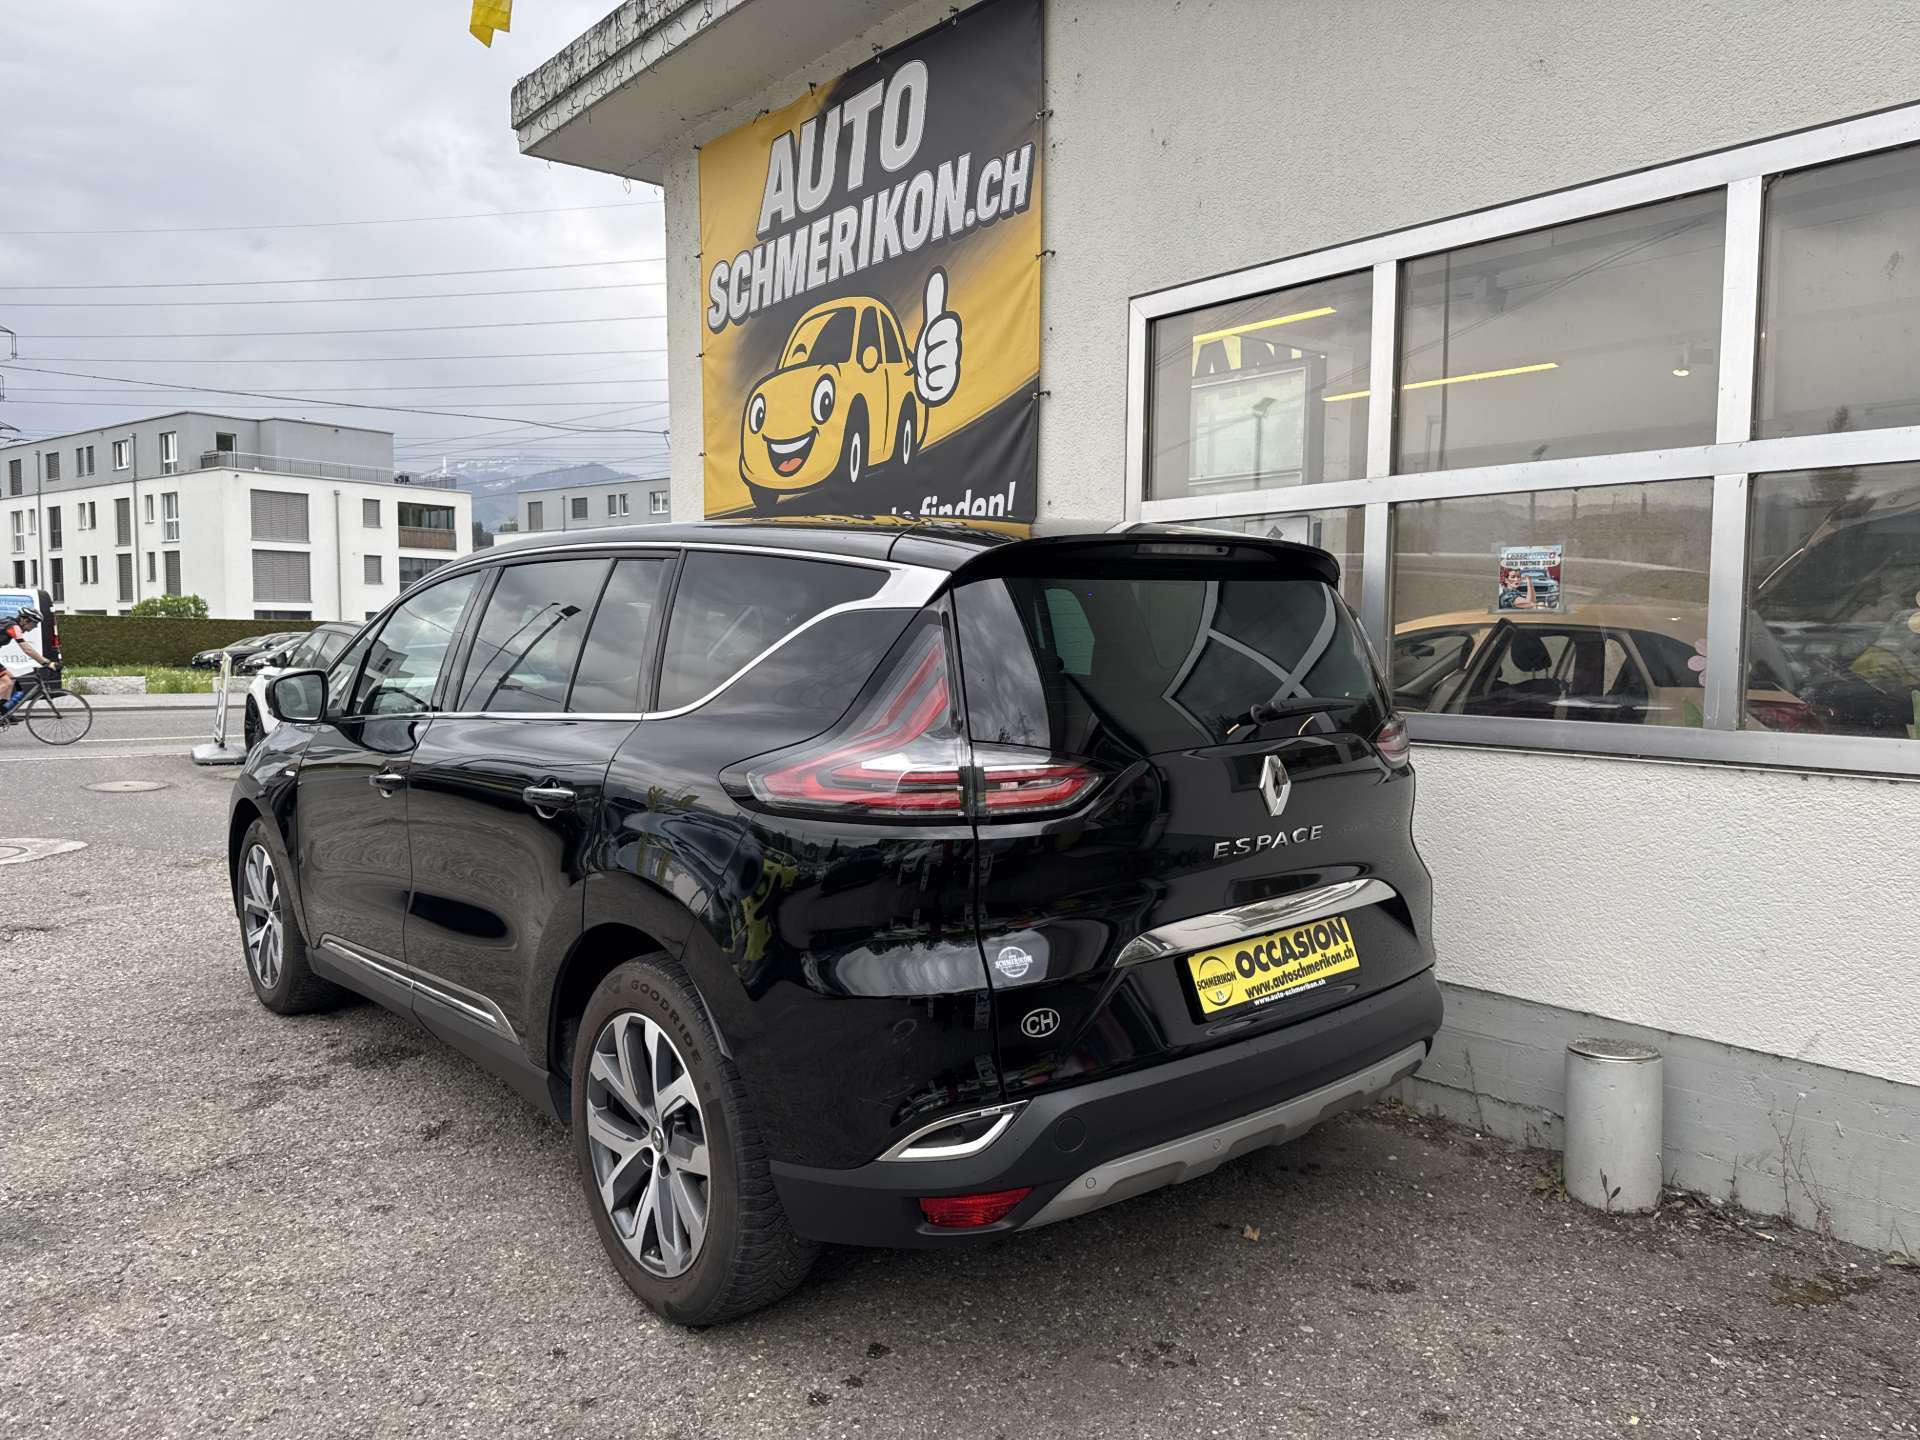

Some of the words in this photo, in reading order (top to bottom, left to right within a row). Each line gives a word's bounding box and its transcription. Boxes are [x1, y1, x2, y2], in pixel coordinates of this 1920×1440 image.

[757, 59, 929, 237] AUTO
[708, 143, 1034, 331] SCHMERIKON.CH
[1213, 824, 1324, 860] ESPACE
[1235, 918, 1349, 979] OCCASION
[1245, 946, 1355, 999] www.autoschmerikon.ch
[1197, 970, 1237, 991] SCHMERIKON
[631, 980, 702, 1065] GOODRIDE
[1026, 1012, 1054, 1034] CH
